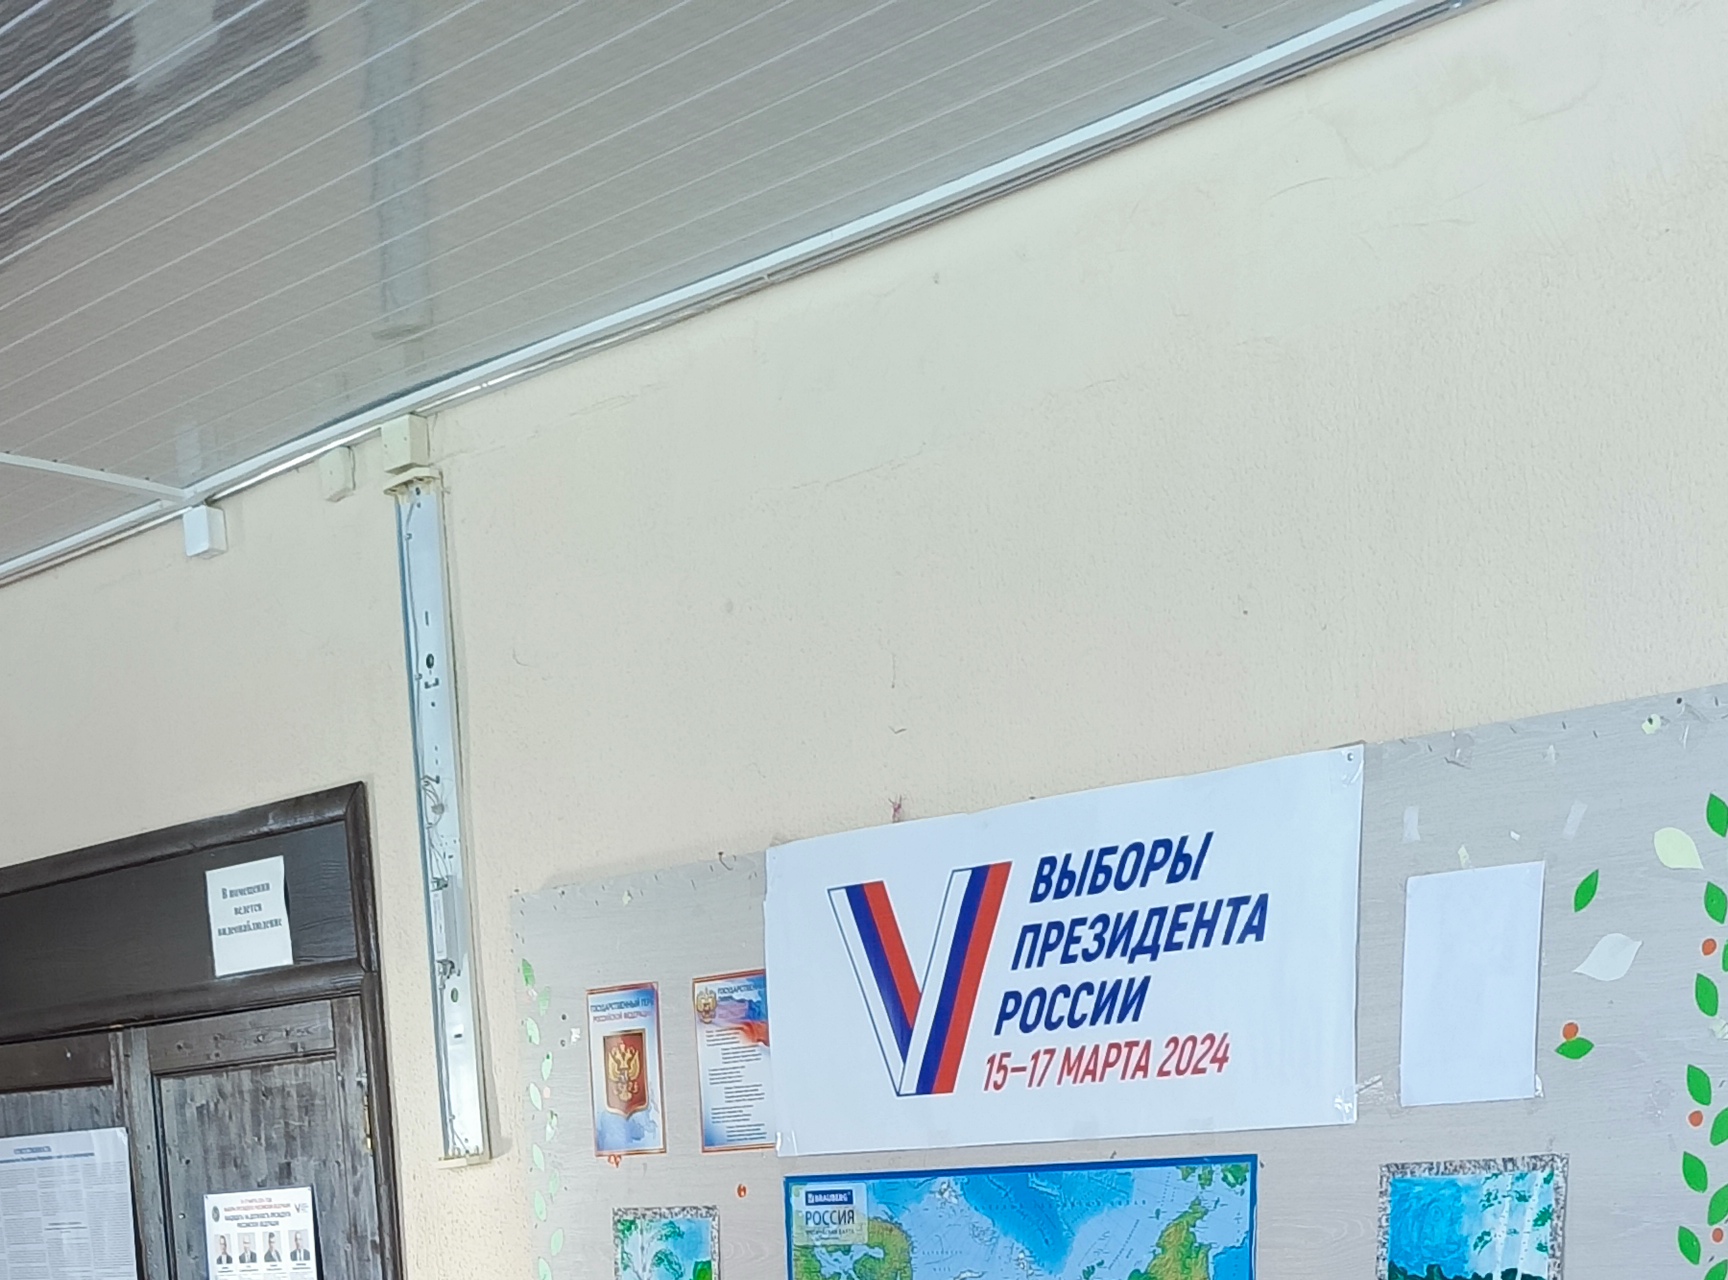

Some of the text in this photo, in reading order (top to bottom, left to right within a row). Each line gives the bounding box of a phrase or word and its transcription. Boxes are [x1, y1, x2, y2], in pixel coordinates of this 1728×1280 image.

[1029, 831, 1214, 903] ВЫБОРЫ
[1010, 893, 1269, 971] ПРЕЗИДЕНТА
[993, 975, 1151, 1036] РОССИИ
[1056, 1039, 1152, 1086] МАРТА
[1156, 1032, 1230, 1078] 2024
[805, 1209, 855, 1226] РОССИЯ
